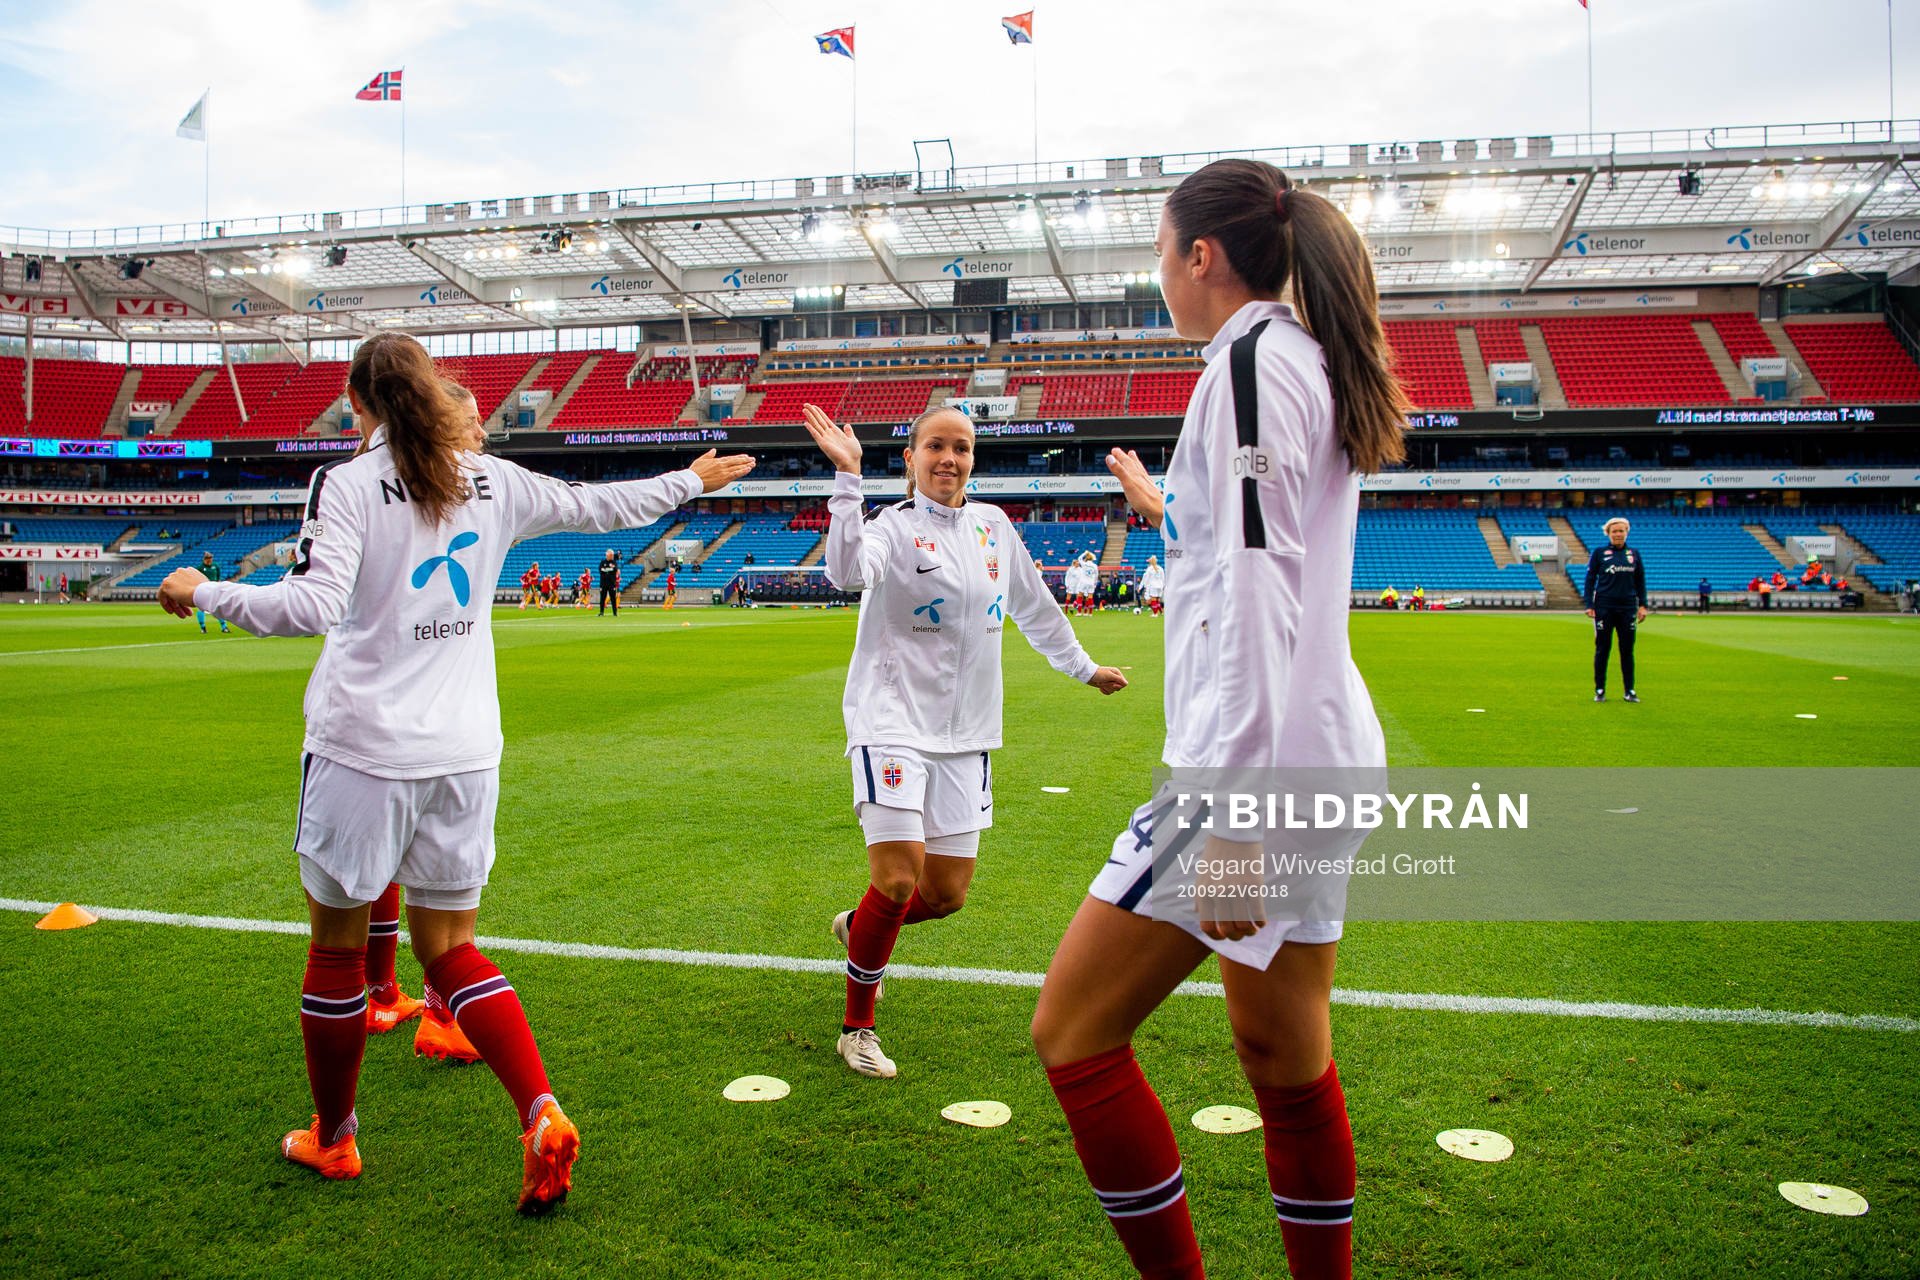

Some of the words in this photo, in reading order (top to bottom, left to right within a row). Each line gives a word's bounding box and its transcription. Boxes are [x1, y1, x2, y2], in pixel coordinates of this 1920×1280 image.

[1753, 231, 1811, 246] telenor
[1589, 238, 1646, 250] telenor
[965, 260, 1013, 274] telenor
[743, 271, 789, 284] telenor
[610, 278, 654, 291] telenor
[325, 295, 364, 306] telenor
[119, 299, 187, 315] VG
[1758, 362, 1783, 371] telenor
[1505, 367, 1529, 376] telenor
[1692, 409, 1722, 423] med
[1839, 407, 1876, 421] T-We
[59, 442, 113, 455] VG
[138, 443, 185, 456] VG
[1233, 455, 1269, 475] DNB
[1363, 477, 1392, 486] telenor
[1431, 476, 1461, 485] telenor
[1500, 476, 1530, 484] telenor
[1570, 475, 1600, 484] telenor
[1641, 475, 1672, 484] telenor
[1713, 474, 1744, 483] telenor
[1785, 474, 1816, 483] telenor
[1859, 473, 1890, 483] telenor
[742, 484, 767, 493] telenor
[799, 483, 824, 491] telenor
[977, 481, 1005, 489] telenor
[1039, 480, 1066, 489] telenor
[38, 494, 79, 503] VG
[82, 494, 121, 504] VG
[125, 495, 163, 504] VG
[165, 494, 200, 504] VG
[1529, 541, 1554, 549] telenor
[1805, 541, 1832, 549] telenor
[0, 548, 41, 558] VG
[56, 549, 98, 559] VG
[912, 625, 942, 634] telenor
